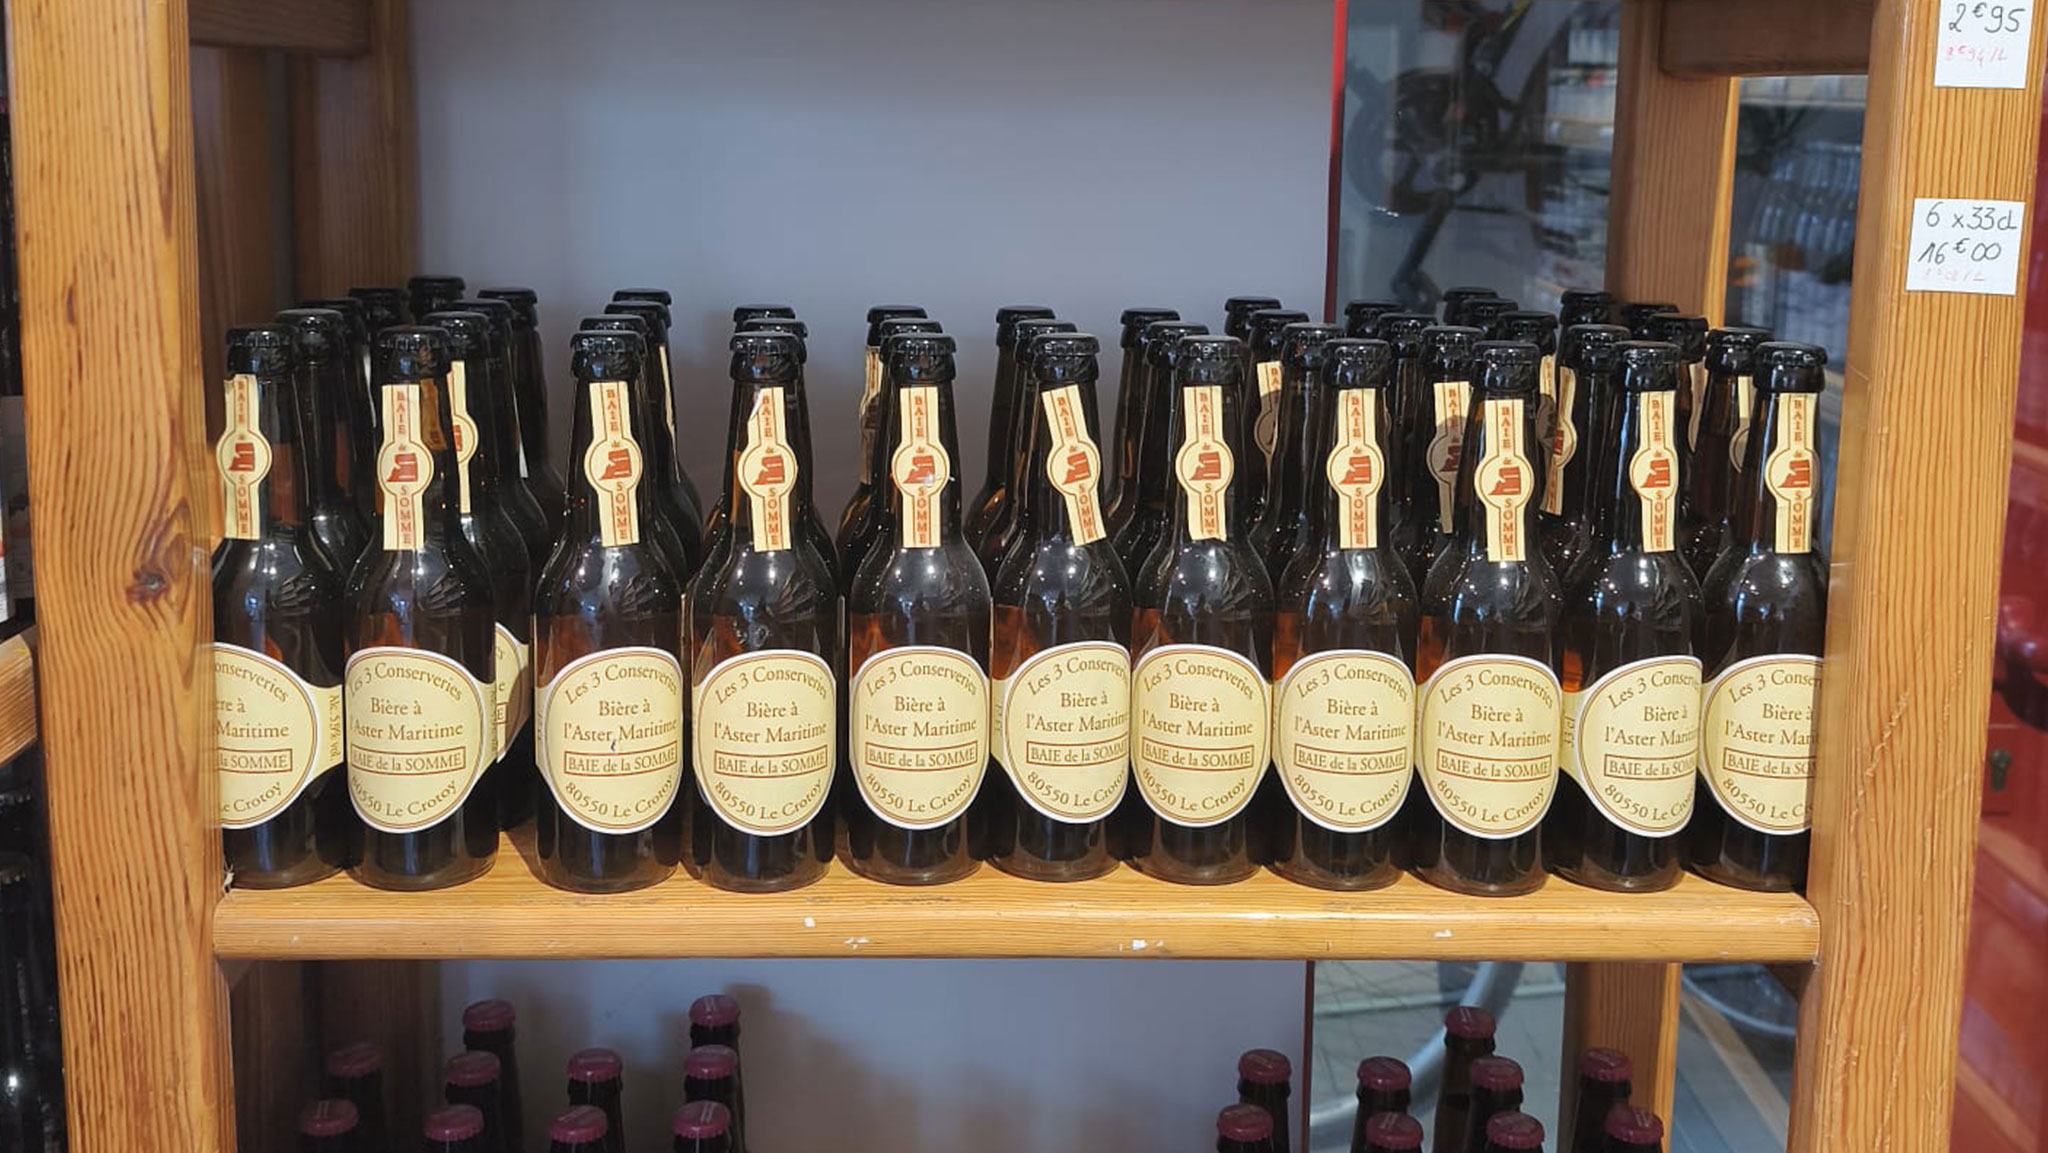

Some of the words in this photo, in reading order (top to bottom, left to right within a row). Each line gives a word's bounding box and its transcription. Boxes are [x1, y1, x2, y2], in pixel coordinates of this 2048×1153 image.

[1917, 237, 2002, 265] 16€00
[396, 392, 405, 435] BAIE
[914, 396, 924, 438] BAIE
[1200, 393, 1209, 435] BAIE
[1351, 396, 1361, 438] BAIE
[1501, 407, 1511, 448] BAIE
[1652, 400, 1661, 441] BAIE
[606, 389, 618, 433] BAIE
[616, 482, 627, 540] SOMME
[762, 396, 772, 437] BAIE
[767, 488, 778, 546] SOMME
[1058, 397, 1071, 437] BAIE
[1078, 484, 1094, 539] SOMME
[400, 485, 412, 543] SOMME
[917, 487, 927, 543] SOMME
[1353, 488, 1364, 545] SOMME
[1503, 498, 1514, 555] SOMME
[1655, 491, 1663, 547] SOMME
[1793, 492, 1803, 547] SOMME
[365, 668, 372, 684] 3
[375, 662, 462, 701] Conserveries
[565, 682, 588, 704] Les
[591, 672, 601, 688] 3
[715, 683, 737, 704] Les
[740, 672, 749, 689] 3
[753, 666, 827, 699] Conserveries
[866, 675, 886, 697] Les
[888, 666, 896, 683] 3
[900, 661, 976, 696] Conserveries
[1028, 673, 1051, 695] Les
[1055, 664, 1063, 680] 3
[1143, 673, 1162, 692] Les
[1163, 664, 1172, 679] 3
[1175, 659, 1254, 700] Conserveries
[1296, 678, 1318, 698] Les
[1321, 669, 1330, 685] 3
[1334, 663, 1408, 701] Conserveries
[1439, 683, 1462, 703] Les
[1465, 674, 1474, 691] 3
[1478, 669, 1553, 709] Conserveries
[1608, 688, 1634, 709] Les
[1638, 678, 1647, 693] 3
[1728, 683, 1754, 703] Les
[1756, 674, 1766, 691] 3
[237, 698, 246, 712] à
[371, 698, 408, 714] Bière
[413, 701, 422, 714] à
[600, 700, 639, 716] Bière
[643, 699, 651, 713] à
[747, 701, 786, 718] Bière
[791, 701, 798, 716] à
[895, 696, 933, 712] Bière
[938, 697, 945, 711] à
[1060, 692, 1098, 708] Bière
[1169, 692, 1208, 712] Bière
[1212, 698, 1220, 712] à
[1327, 698, 1366, 715] Bière
[1371, 701, 1378, 715] à
[1471, 704, 1511, 722] Bière
[1516, 708, 1523, 722] à
[1643, 706, 1679, 722] Bière
[1762, 703, 1802, 720] Bière
[217, 723, 289, 738] Maritime
[389, 724, 463, 740] Maritime
[564, 722, 612, 741] l'Aster
[618, 719, 677, 741] Maritime
[714, 722, 761, 743] l'Aster
[766, 723, 827, 743] Maritime
[865, 714, 908, 736] l'Aster
[913, 719, 977, 737] Maritime
[1026, 714, 1074, 732] l'Aster
[1142, 709, 1182, 734] l'Aster
[1187, 720, 1253, 737] Maritime
[1295, 716, 1340, 739] l'Aster
[1345, 724, 1407, 741] Maritime
[1438, 720, 1484, 745] l'Aster
[1489, 730, 1551, 748] Maritime
[1605, 726, 1656, 746] l'Aster
[1725, 720, 1775, 745] l'Aster
[231, 756, 287, 769] SOMME
[376, 757, 388, 770] de
[392, 760, 400, 771] la
[405, 753, 461, 771] SOMME
[568, 758, 599, 772] BAIE
[603, 759, 618, 772] de
[621, 758, 631, 771] la
[634, 749, 675, 770] SOMME
[718, 757, 747, 772] BAIE
[750, 761, 765, 773] de
[768, 761, 778, 773] la
[781, 751, 825, 772] SOMME
[869, 749, 894, 765] BAIE
[898, 754, 912, 767] de
[915, 755, 925, 767] la
[929, 747, 975, 767] SOMME
[1030, 747, 1061, 762] BAIE
[1064, 750, 1078, 762] de
[1081, 750, 1090, 762] la
[1145, 743, 1169, 759] BAIE
[1172, 752, 1185, 765] de
[1188, 752, 1198, 766] la
[1201, 751, 1251, 767] SOMME
[1298, 750, 1326, 767] BAIE
[1329, 757, 1344, 770] de
[1347, 757, 1357, 770] la
[1360, 757, 1404, 771] SOMME
[1441, 755, 1471, 773] BAIE
[1473, 763, 1488, 777] de
[1491, 763, 1501, 777] la
[1504, 764, 1548, 777] SOMME
[1609, 760, 1642, 775] BAIE
[1645, 763, 1659, 776] de
[1661, 762, 1670, 775] la
[1728, 754, 1760, 772] BAIE
[1763, 761, 1778, 774] de
[1781, 762, 1791, 774] la
[233, 781, 281, 812] Crotoy
[386, 803, 403, 817] Le
[408, 781, 457, 815] Crotoy
[566, 782, 608, 815] 80550
[614, 805, 630, 818] Le
[715, 781, 755, 817] 80550
[760, 807, 777, 819] Le
[782, 779, 821, 816] Crotoy
[866, 774, 903, 809] 80550
[908, 799, 925, 812] Le
[930, 775, 971, 810] Crotoy
[1028, 771, 1069, 805] 80550
[1074, 794, 1090, 806] Le
[1143, 768, 1176, 806] 80550
[1180, 798, 1197, 811] Le
[1202, 778, 1246, 811] Crotoy
[1294, 774, 1334, 811] 80550
[1339, 802, 1356, 815] Le
[1360, 780, 1400, 814] Crotoy
[1438, 779, 1477, 817] 80550
[1482, 809, 1499, 823] Le
[1504, 788, 1545, 821] Crotoy
[1604, 784, 1649, 818] 80550
[1653, 808, 1668, 820] Le
[1723, 778, 1765, 815] 80550
[1770, 806, 1788, 820] Le
